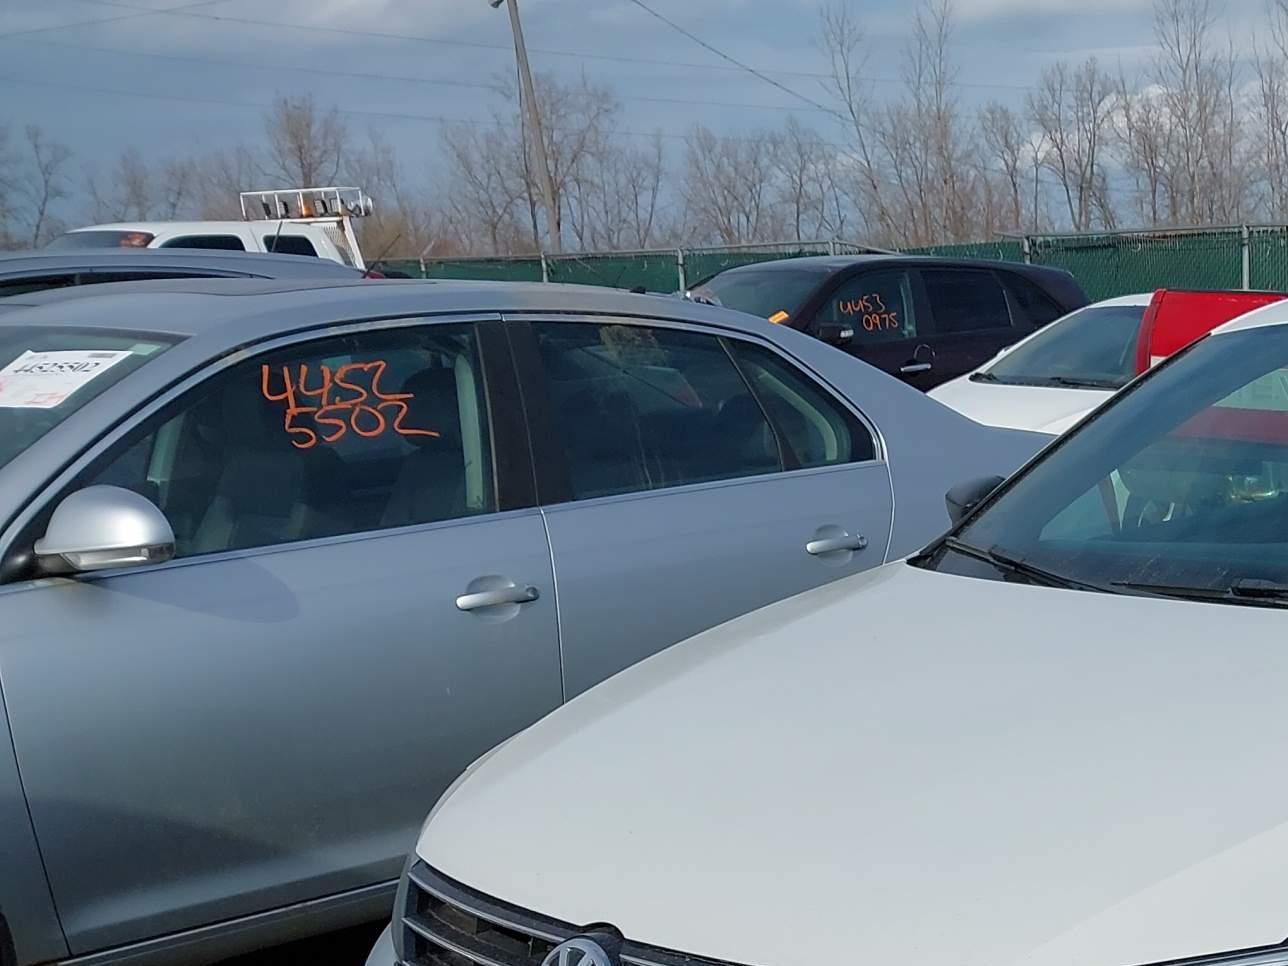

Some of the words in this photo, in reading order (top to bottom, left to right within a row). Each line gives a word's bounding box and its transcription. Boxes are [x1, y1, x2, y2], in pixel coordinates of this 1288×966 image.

[839, 293, 886, 316] 4453
[862, 312, 899, 331] 0975
[262, 360, 415, 412] 4452
[285, 400, 441, 449] 5502
